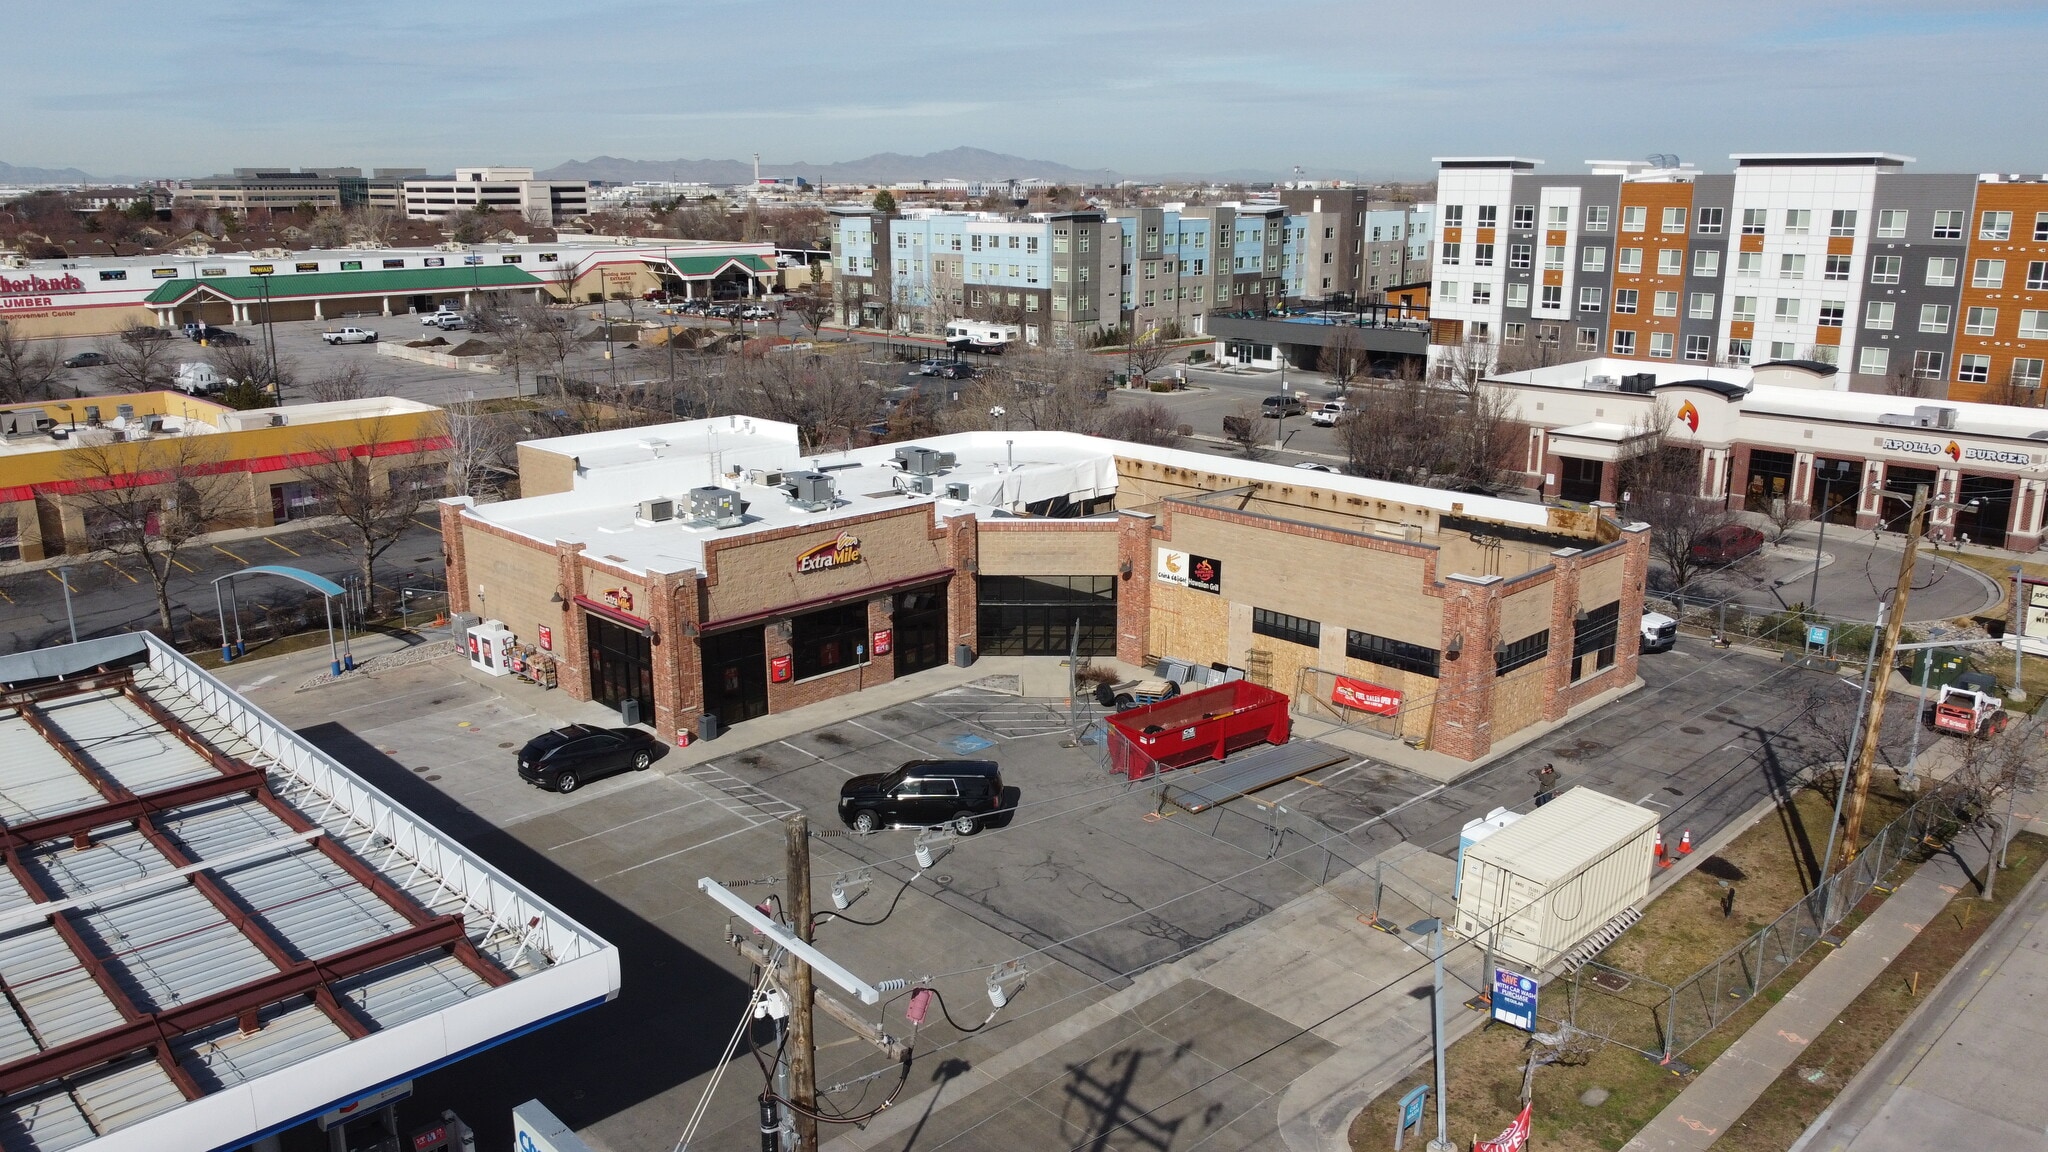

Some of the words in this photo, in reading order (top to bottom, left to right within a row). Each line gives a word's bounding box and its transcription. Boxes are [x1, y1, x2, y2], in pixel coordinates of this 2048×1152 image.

[0, 297, 52, 308] UMBER
[1883, 439, 1942, 455] APOLLO
[1965, 448, 2030, 465] BURGER
[1188, 578, 1209, 589] Hawaiian
[1210, 583, 1219, 591] Grill
[1501, 973, 1518, 987] SAVE
[1501, 988, 1529, 1003] PURCHASE
[1509, 985, 1521, 994] CAR
[1521, 989, 1536, 1000] WASH
[1504, 996, 1524, 1007] REGULAR
[1407, 1107, 1420, 1120] WASH
[1409, 1103, 1419, 1113] CAR
